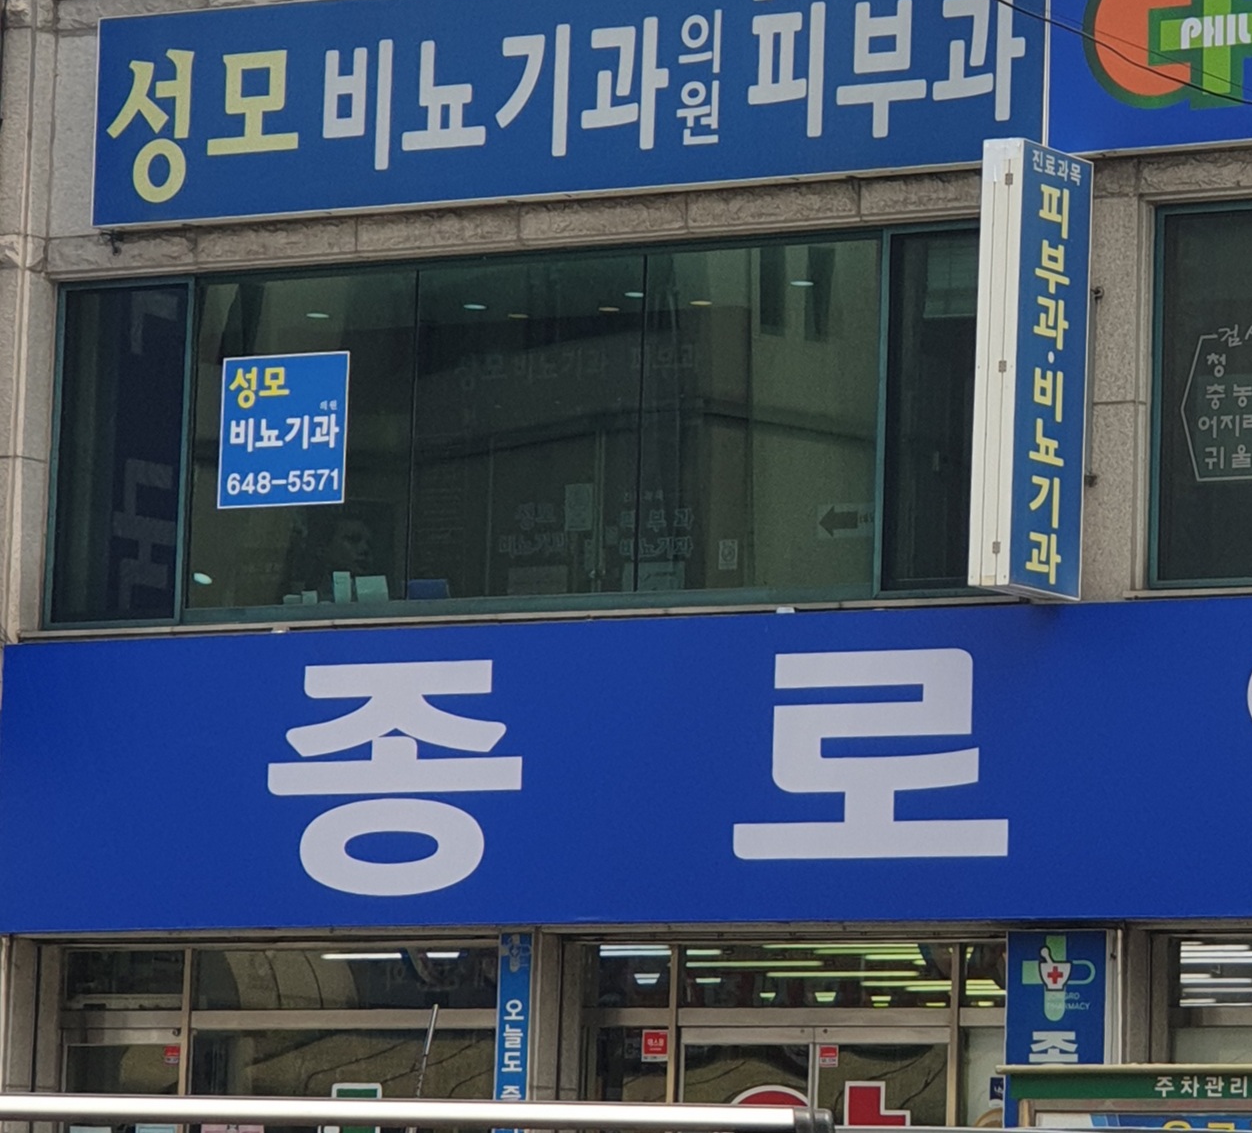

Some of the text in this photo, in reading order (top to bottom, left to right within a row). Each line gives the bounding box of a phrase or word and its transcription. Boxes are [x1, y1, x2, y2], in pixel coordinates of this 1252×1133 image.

[1180, 11, 1251, 50] PHIL
[107, 48, 299, 204] 성모
[322, 16, 669, 171] 비뇨기과
[676, 9, 723, 146] 의원
[1031, 149, 1082, 186] 진료과목
[229, 366, 290, 409] 성모
[229, 413, 340, 453] 비뇨기과
[226, 468, 339, 496] 648-5571
[501, 999, 524, 1072] 오늘도
